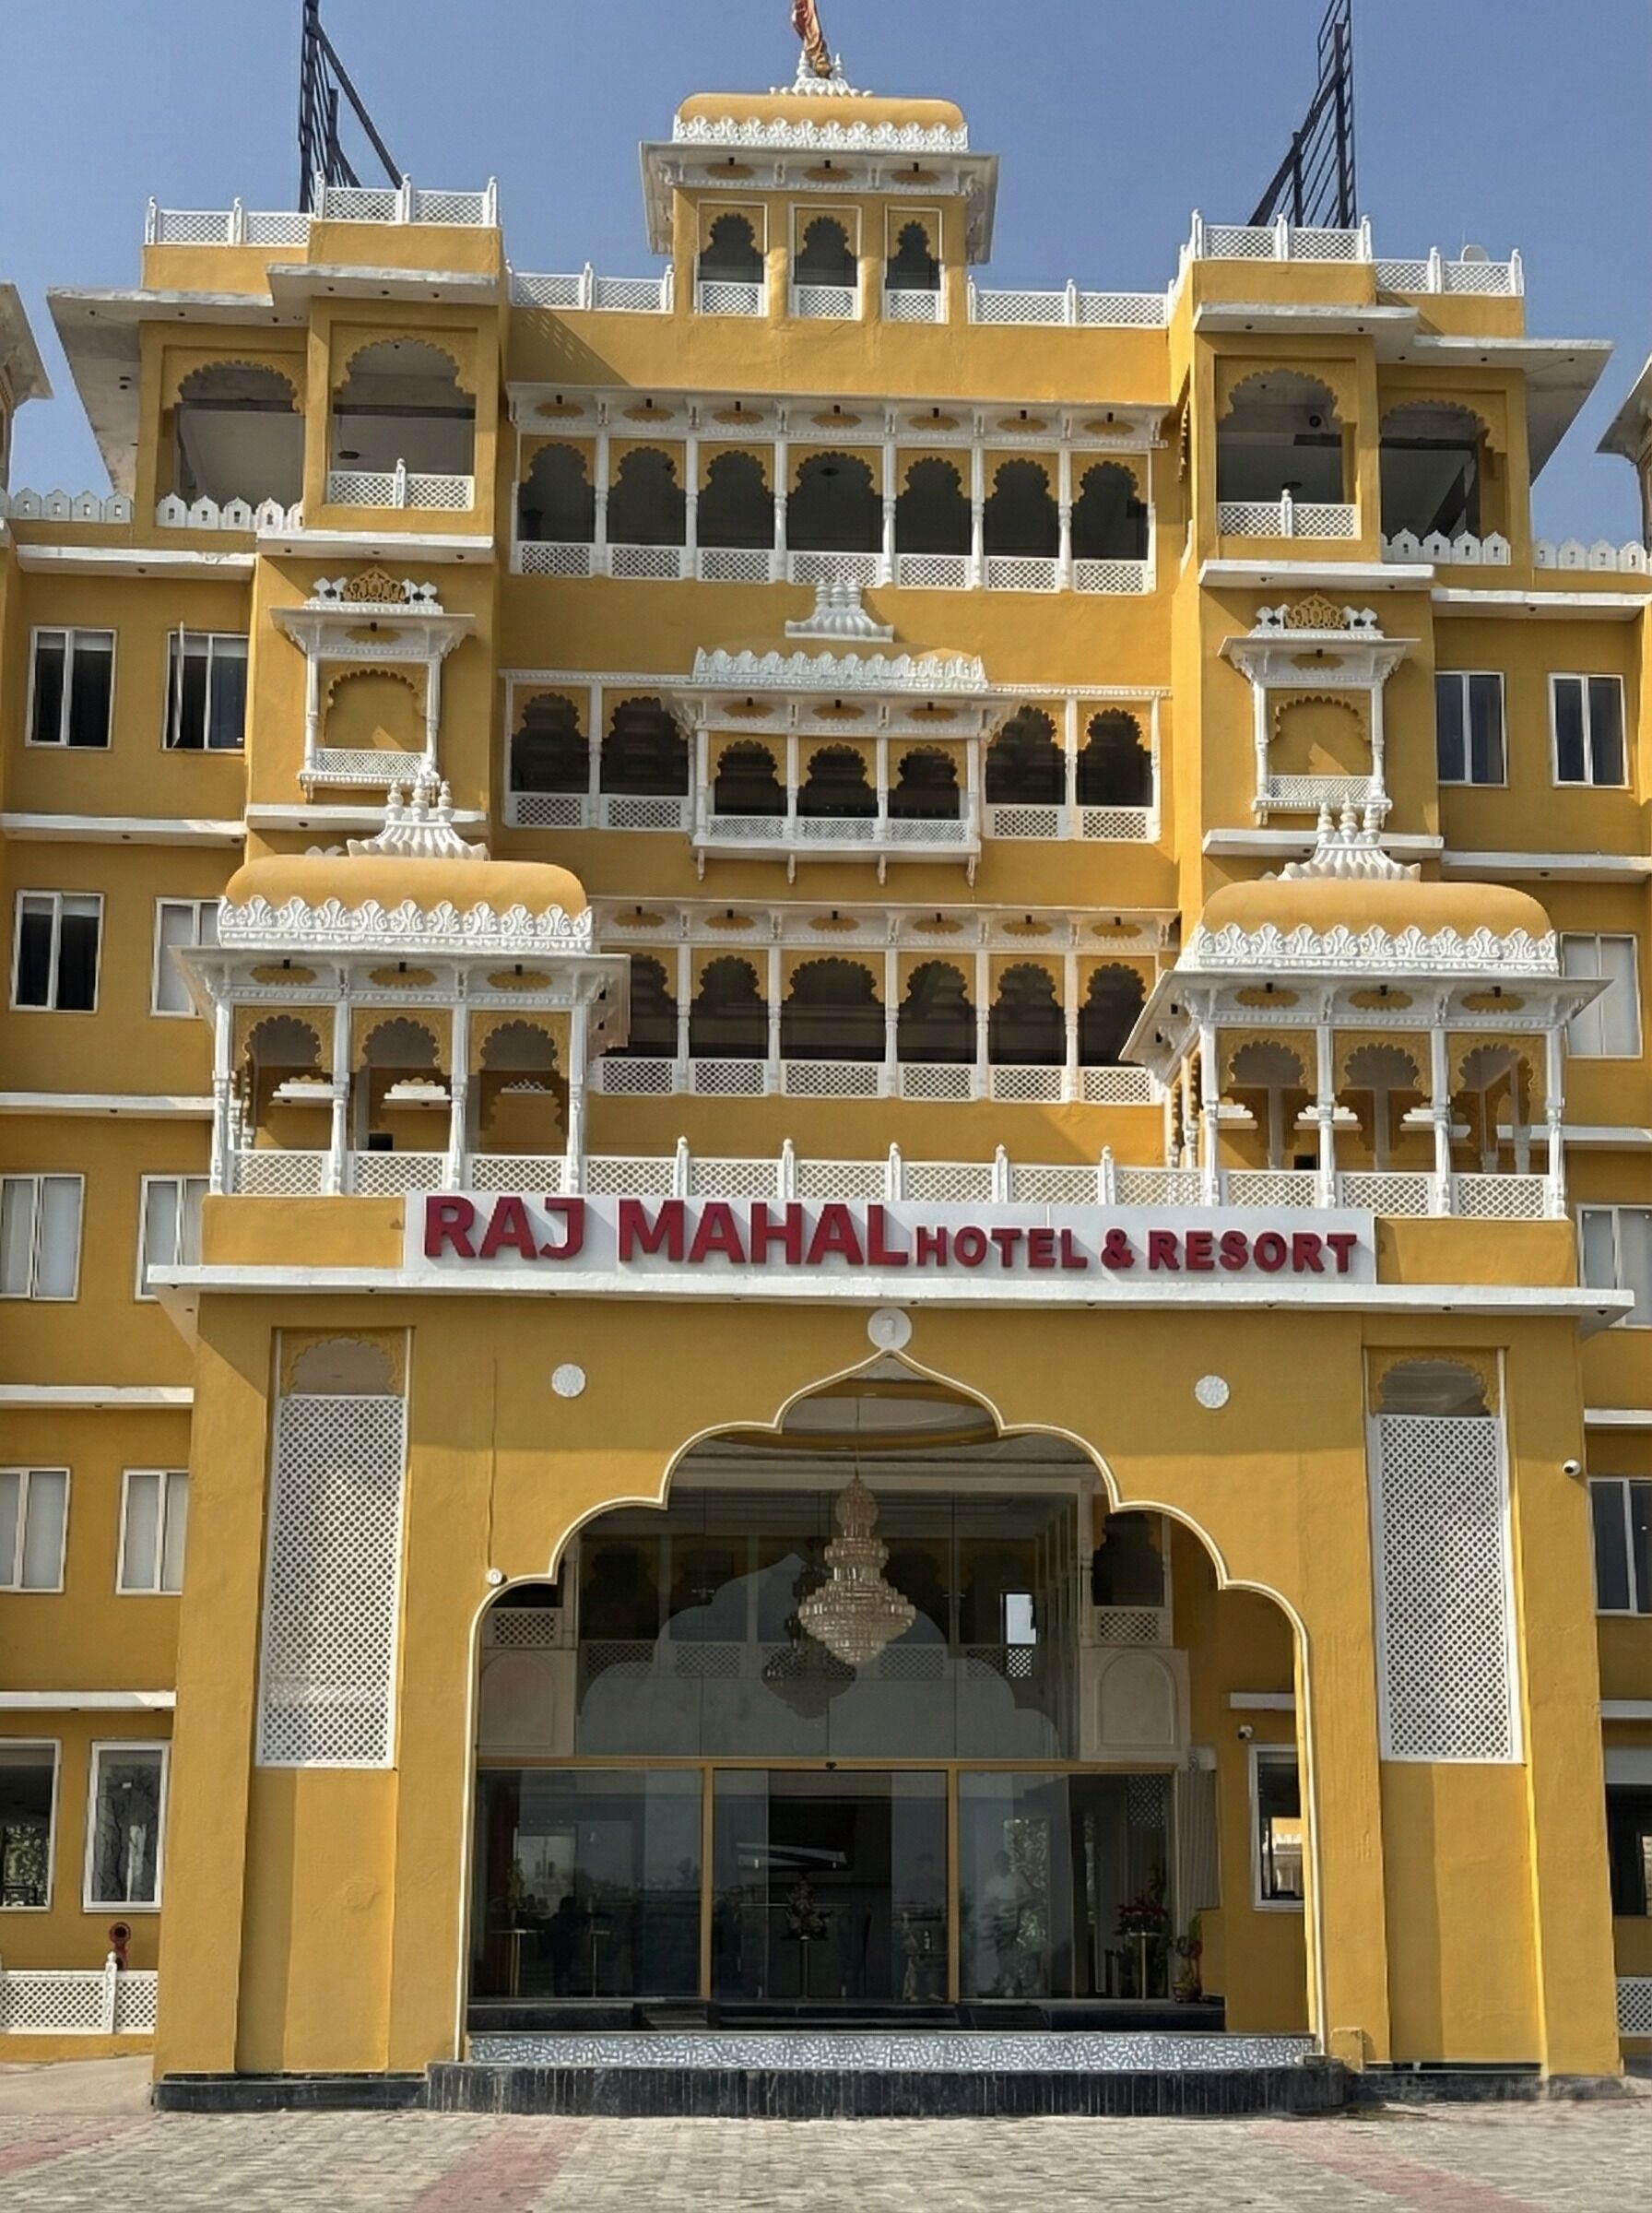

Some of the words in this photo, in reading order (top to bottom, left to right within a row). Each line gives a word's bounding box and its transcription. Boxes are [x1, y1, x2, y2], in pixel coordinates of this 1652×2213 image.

[424, 1195, 585, 1260] RAJ
[618, 1199, 910, 1266] MAHAL
[915, 1225, 1088, 1269] HOTEL
[1148, 1229, 1358, 1273] RESORT
